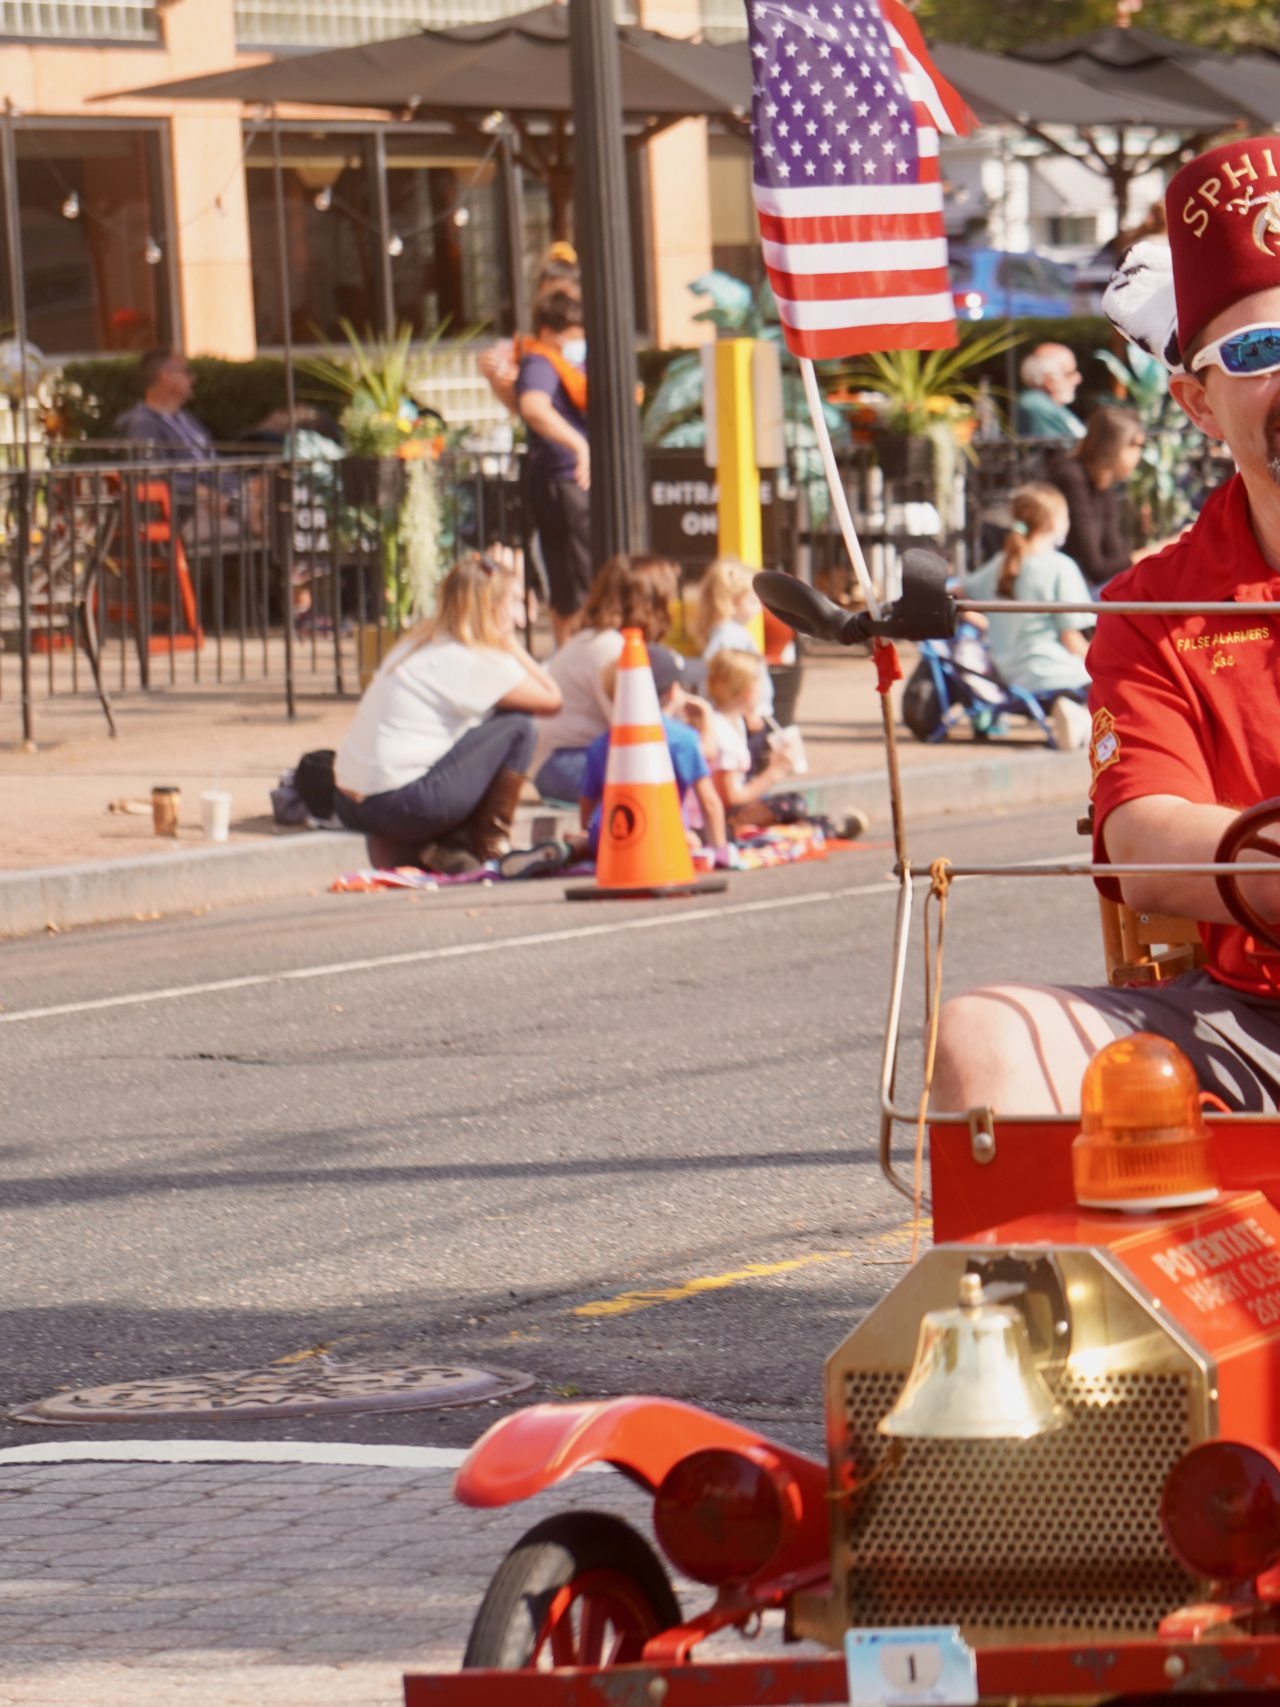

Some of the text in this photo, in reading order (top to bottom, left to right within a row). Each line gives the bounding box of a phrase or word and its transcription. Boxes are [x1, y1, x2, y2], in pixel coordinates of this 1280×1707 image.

[652, 481, 771, 505] ENTRAE
[681, 511, 719, 536] ON
[1177, 627, 1269, 653] FALSE ALARMERS
[1152, 1217, 1276, 1283] POTENTATE
